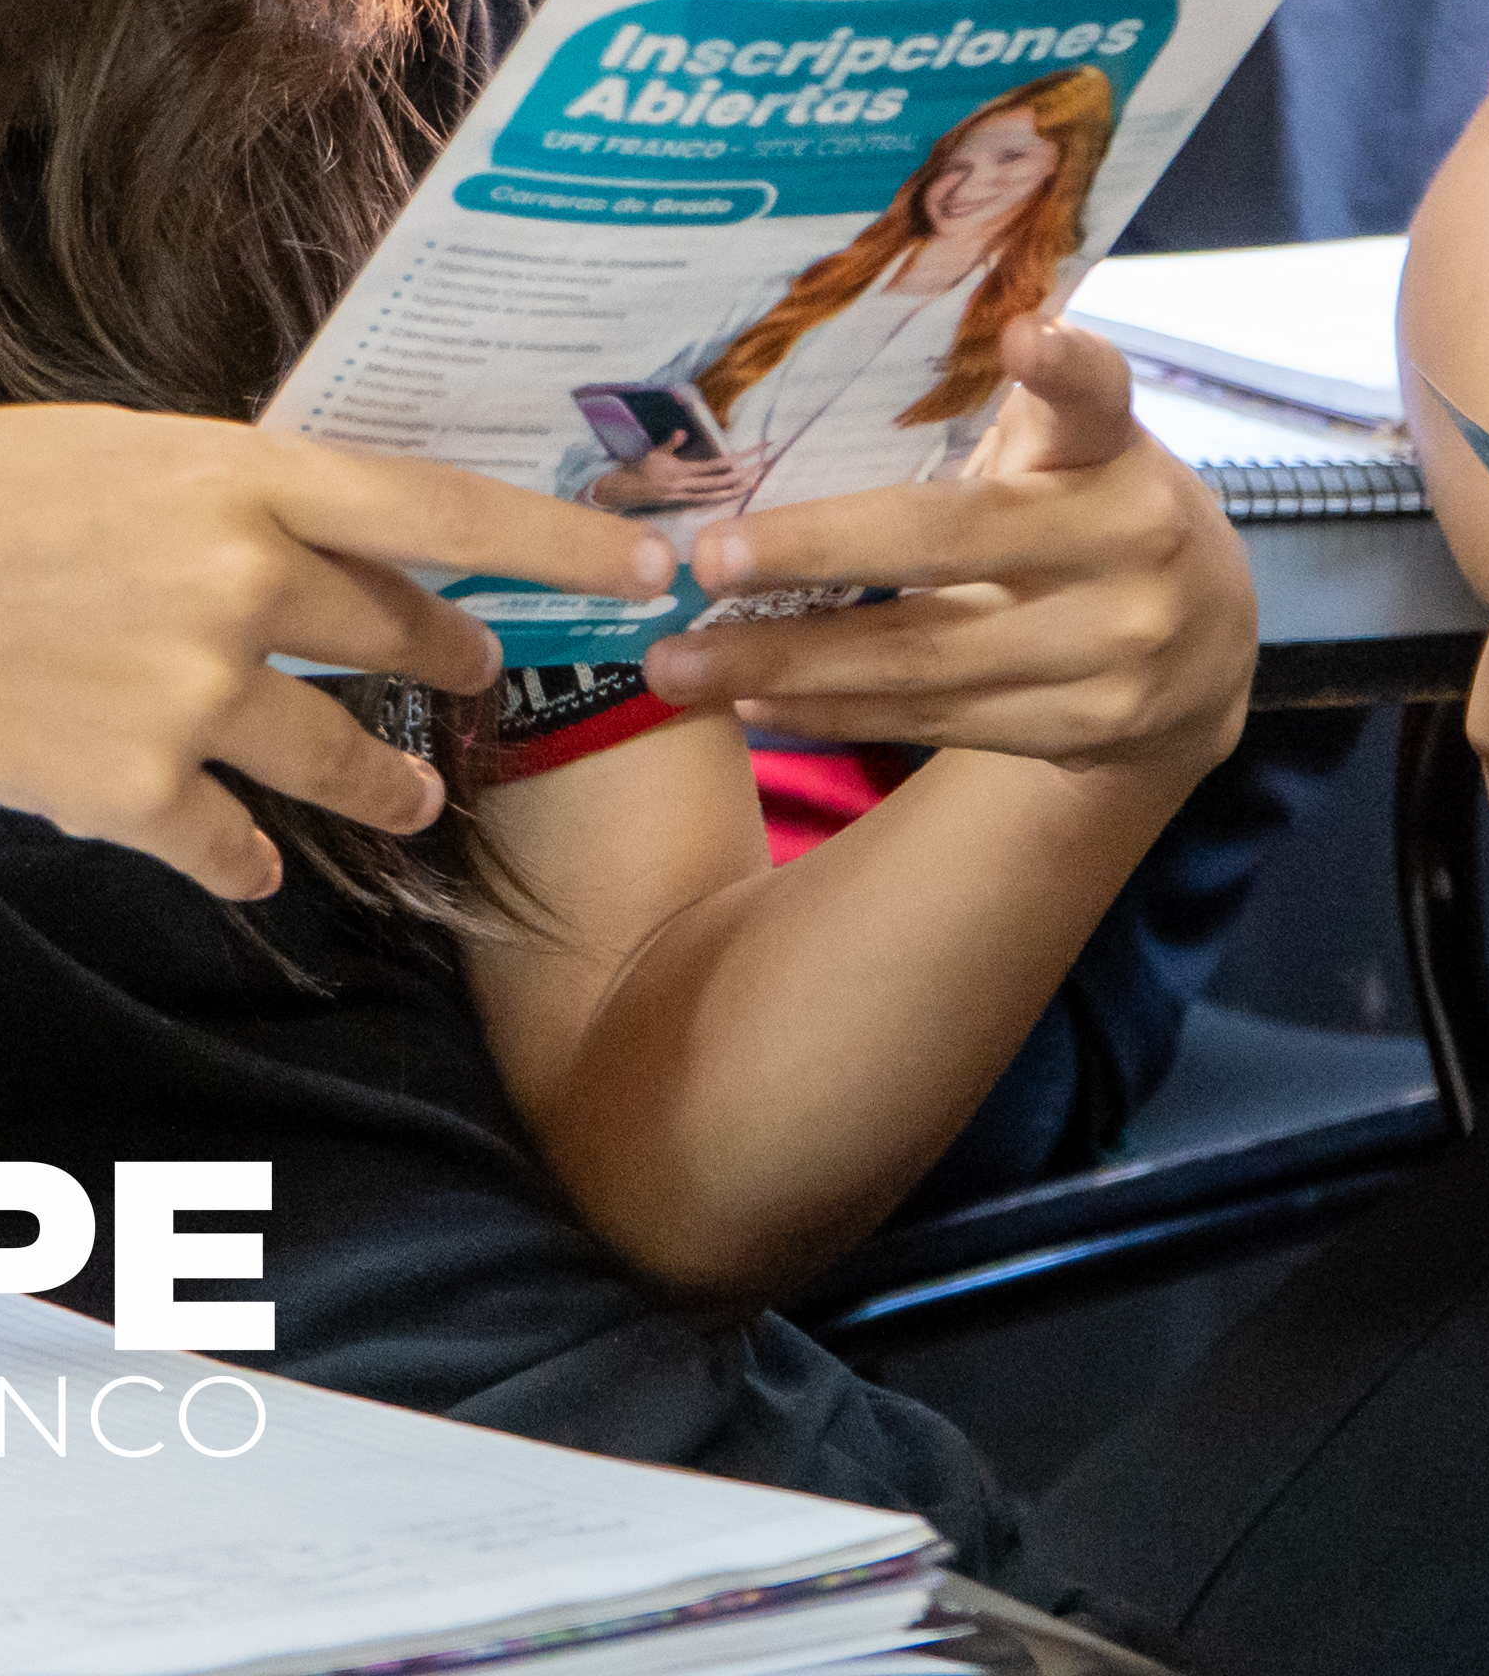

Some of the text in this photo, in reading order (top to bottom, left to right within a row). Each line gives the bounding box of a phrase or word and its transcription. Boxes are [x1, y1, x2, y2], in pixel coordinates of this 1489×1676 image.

[600, 18, 1143, 89] Inscripciones
[565, 76, 908, 126] Abiertas
[542, 130, 602, 154] UPE
[604, 136, 727, 159] FRANCO
